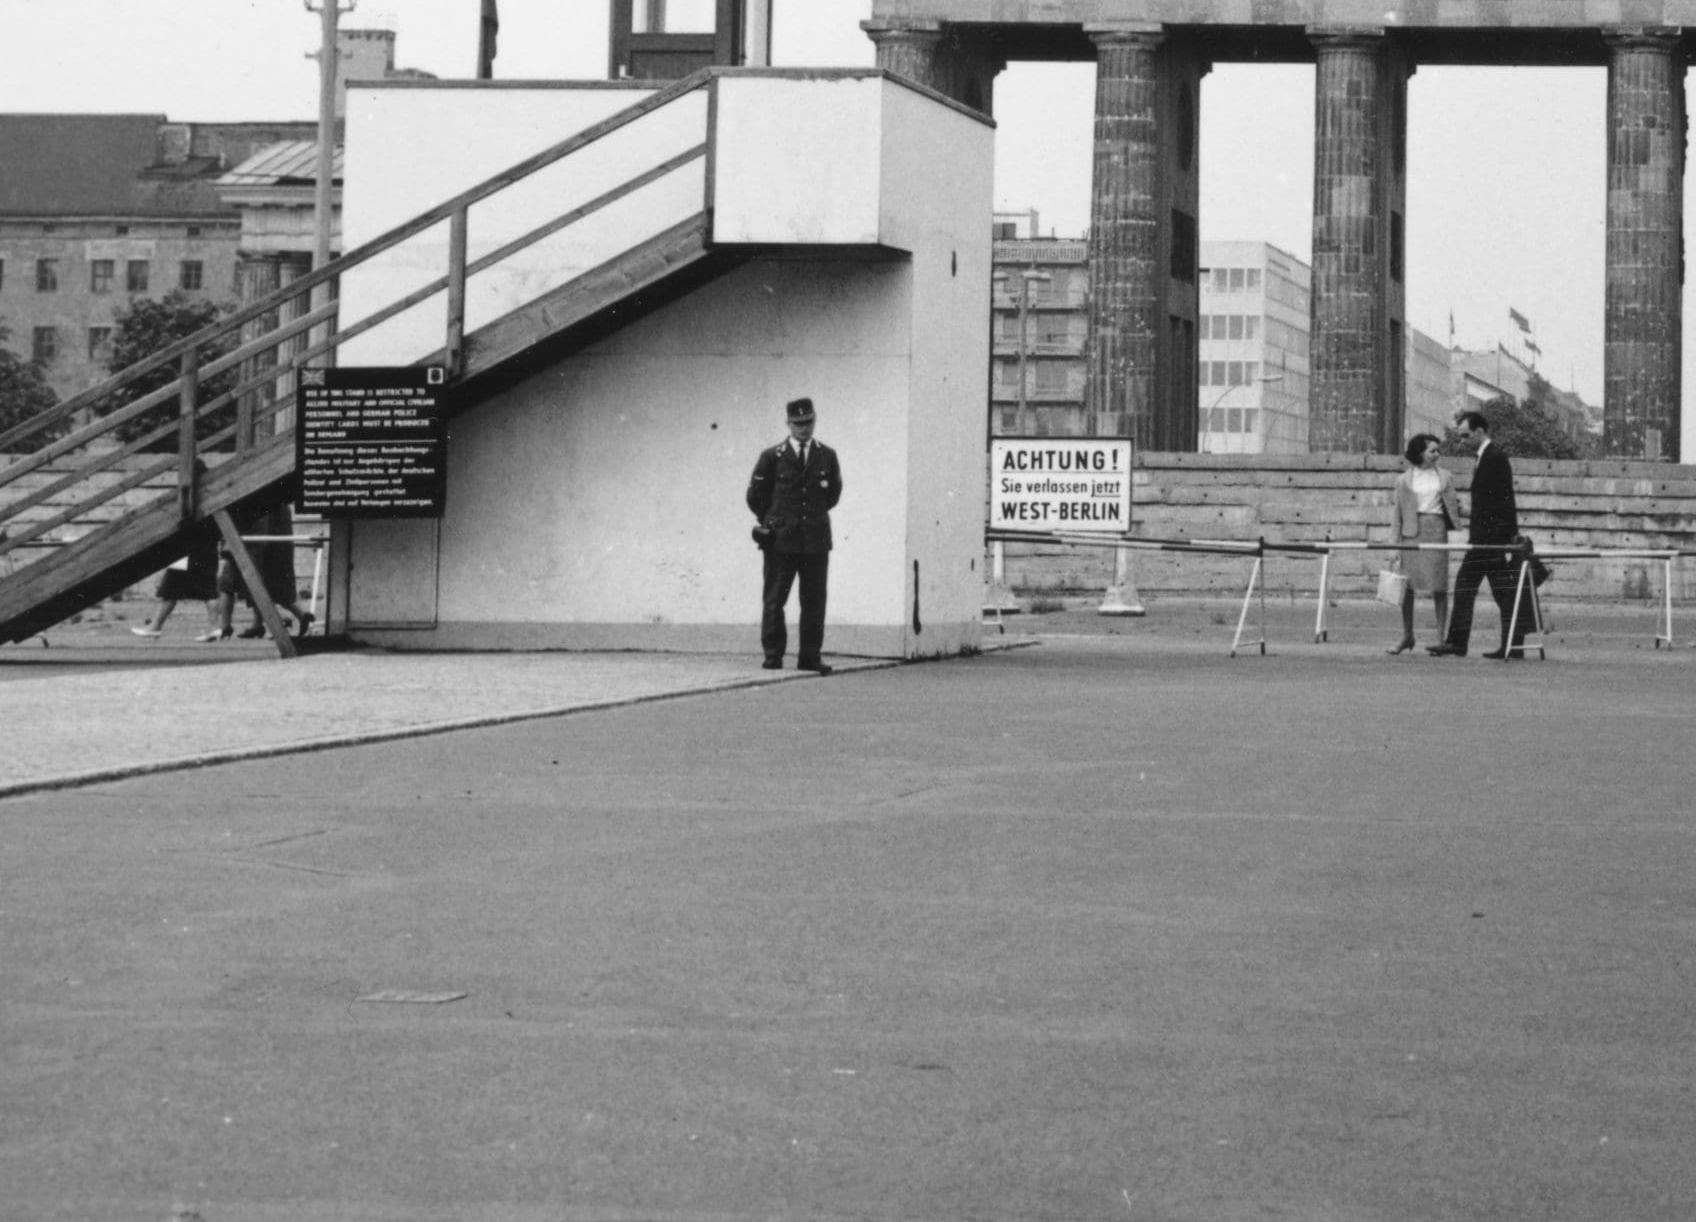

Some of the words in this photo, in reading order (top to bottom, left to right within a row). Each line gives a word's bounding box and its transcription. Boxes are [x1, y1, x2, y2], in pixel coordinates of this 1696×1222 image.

[376, 388, 413, 396] RESTRICTED
[1001, 478, 1022, 494] Sie
[1026, 478, 1088, 494] verlassen
[1090, 479, 1120, 497] jetzt
[1001, 501, 1119, 520] WEST-BERLIN
